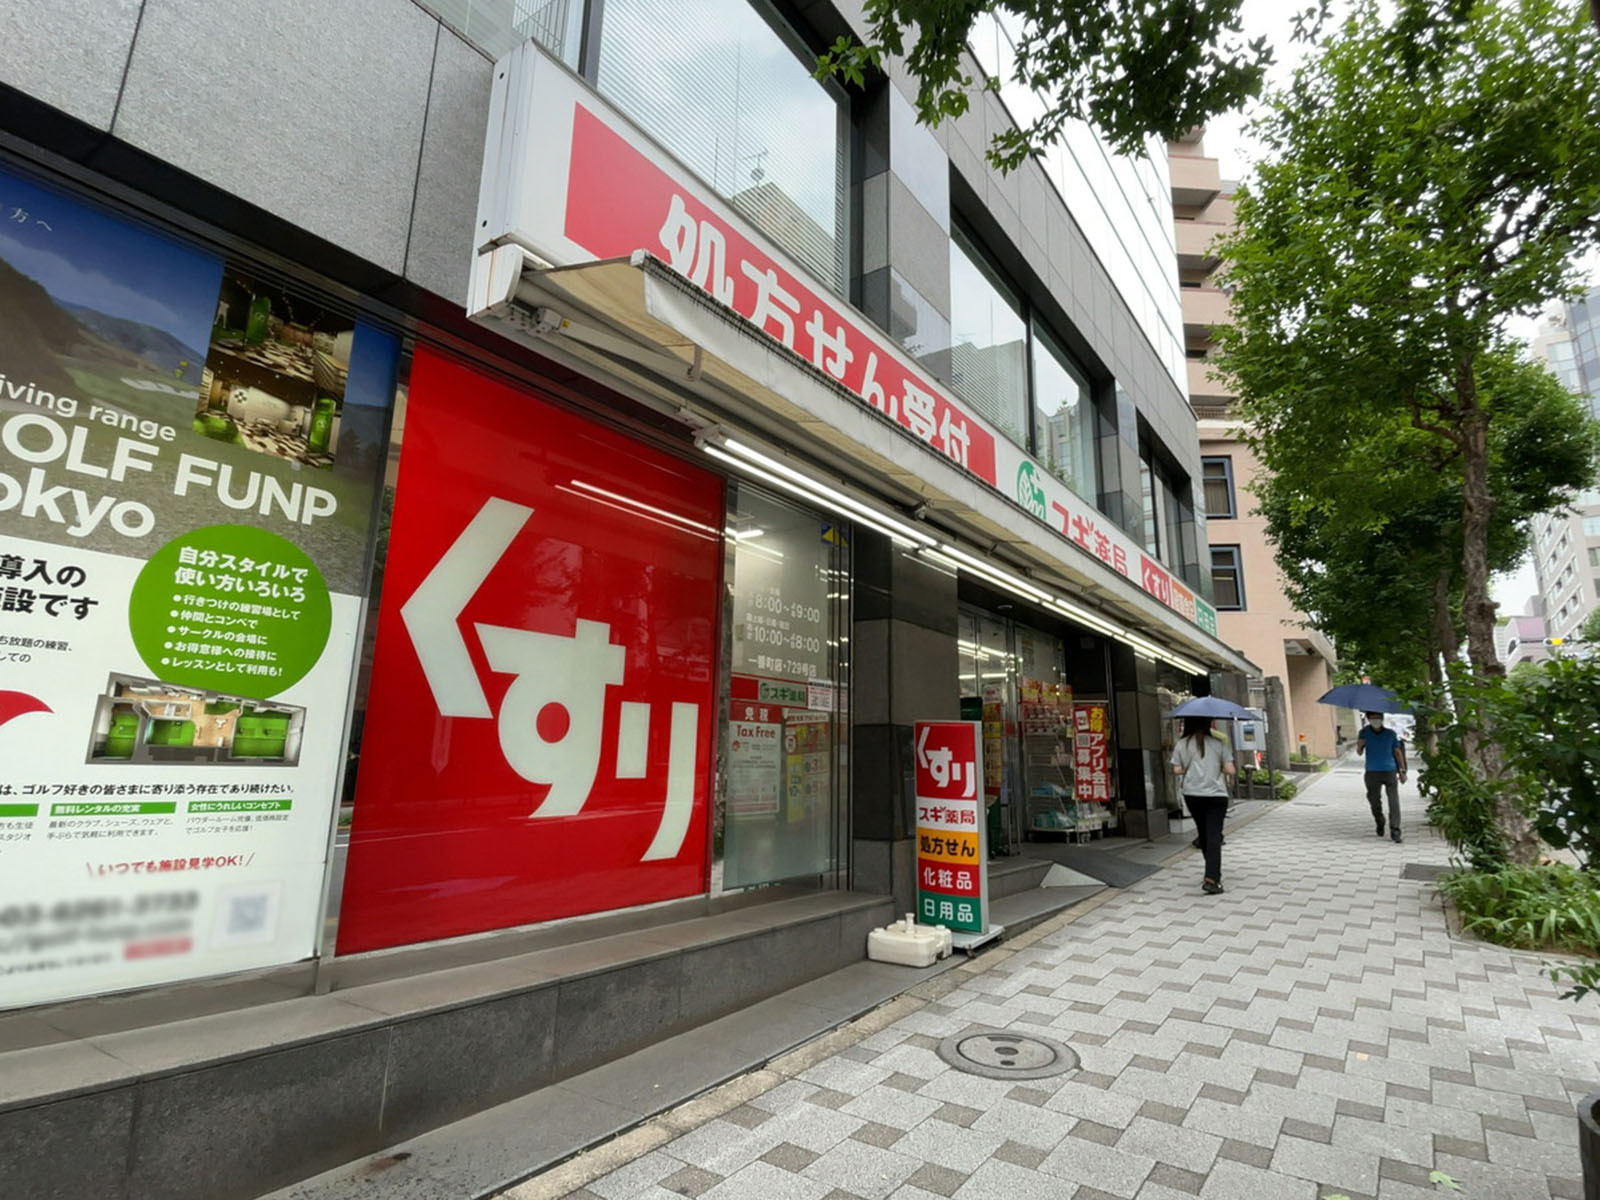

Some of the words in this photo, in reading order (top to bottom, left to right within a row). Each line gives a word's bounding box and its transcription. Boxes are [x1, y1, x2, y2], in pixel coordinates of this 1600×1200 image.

[658, 194, 970, 468] 処方せん受付
[89, 402, 176, 442] range
[2, 413, 160, 482] OLF
[173, 453, 337, 526] FUNP
[178, 546, 309, 583] 自分スタイルで
[175, 566, 306, 603] 使い方いろいろ
[0, 586, 99, 621] 設です
[183, 594, 301, 621] 行きつけの練習場として
[178, 626, 268, 645] サークルの会場に
[174, 642, 277, 661] お得意様への接待に
[400, 496, 699, 861] くすり
[736, 724, 754, 738] Tax
[756, 726, 776, 739] Free
[917, 726, 976, 798] くすり
[919, 805, 976, 826] スギ薬局
[919, 835, 976, 858] 処方せん
[923, 867, 973, 891] 化粧品
[923, 898, 974, 924] 日用品
